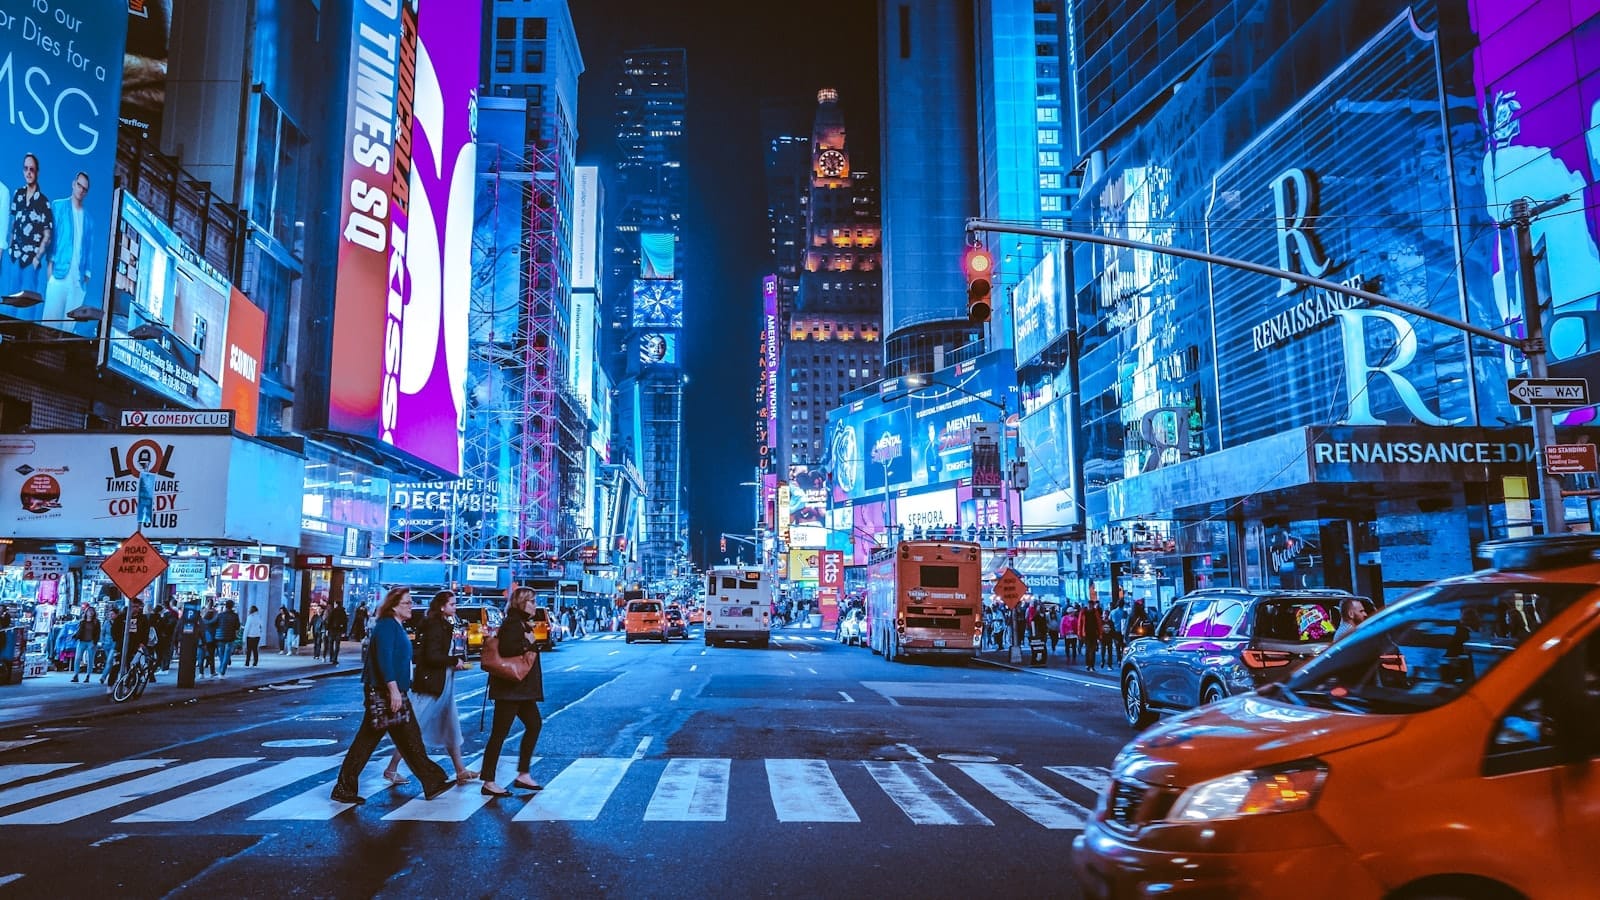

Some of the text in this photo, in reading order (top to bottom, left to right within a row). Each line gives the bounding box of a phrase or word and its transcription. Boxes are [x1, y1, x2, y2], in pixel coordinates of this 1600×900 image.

[54, 8, 83, 33] our
[23, 16, 60, 56] Dies
[67, 40, 90, 71] for
[95, 65, 105, 82] a
[354, 23, 396, 175] TIMES
[344, 179, 388, 253] SQ
[1269, 168, 1330, 298] R
[1253, 274, 1364, 353] RENAISSANCE
[767, 315, 777, 420] AMERICA'S NETWORK
[1331, 308, 1467, 426] R
[1518, 387, 1579, 397] ONE WAY
[1315, 443, 1489, 464] RENAISSANCE
[105, 477, 180, 492] TIMES UARE
[108, 494, 177, 516] CODY
[395, 490, 499, 513] DECEMBER
[908, 510, 944, 526] SEPHORA
[125, 546, 147, 554] ROAD
[825, 553, 840, 584] tkts
